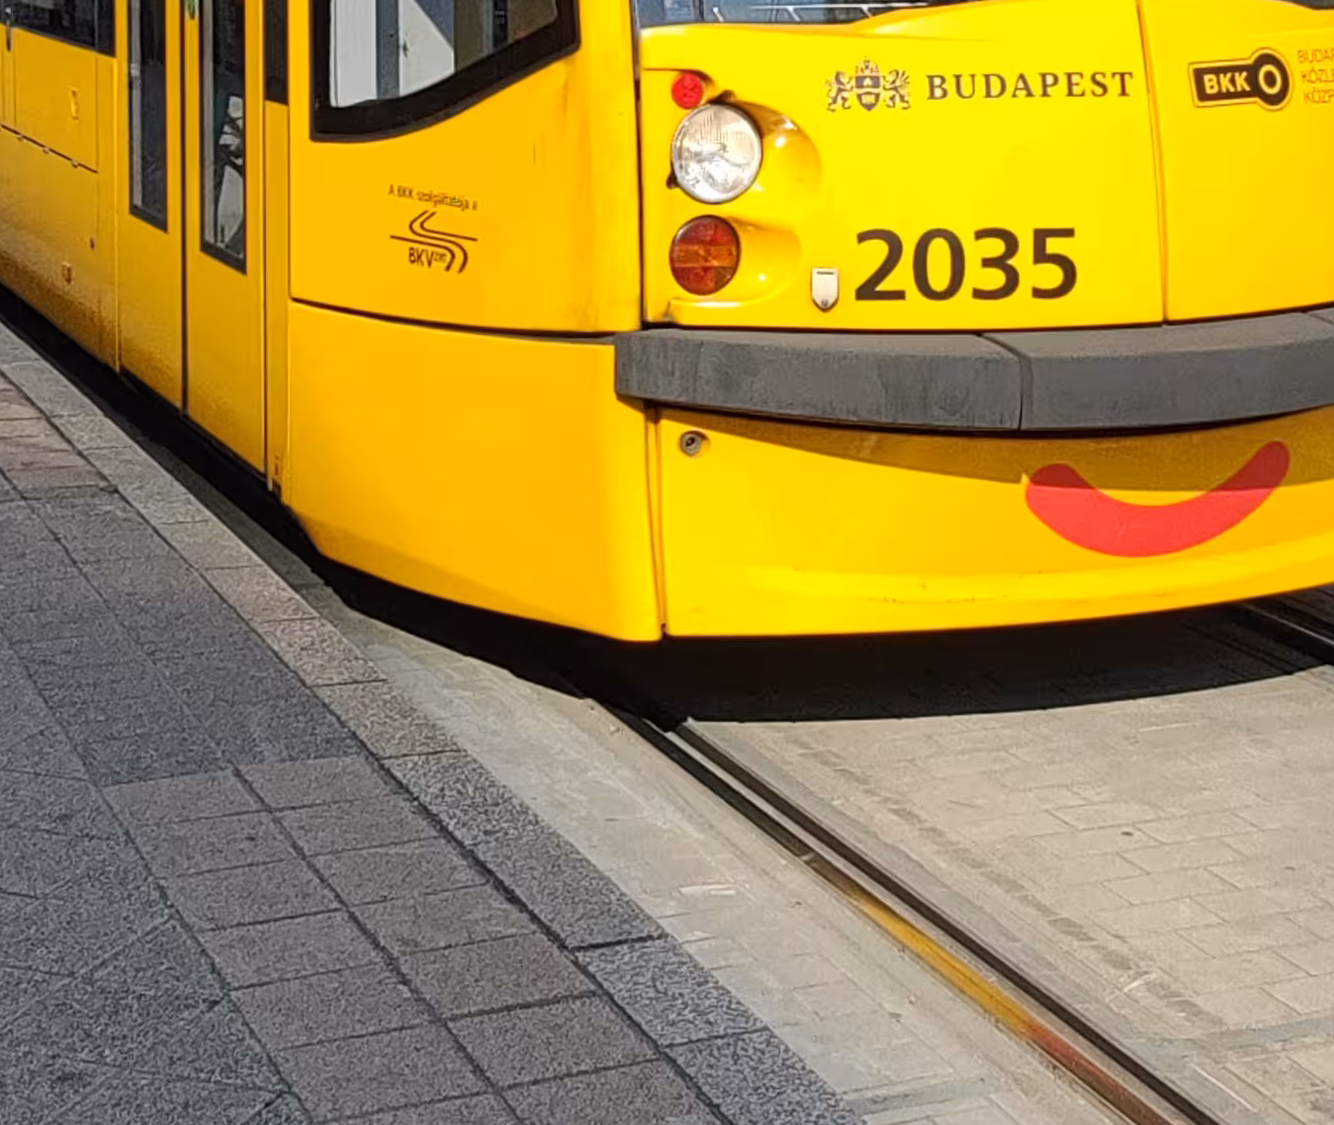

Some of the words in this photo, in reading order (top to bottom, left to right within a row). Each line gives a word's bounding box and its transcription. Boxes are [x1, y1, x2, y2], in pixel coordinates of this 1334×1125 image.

[925, 70, 1135, 101] BUDAPEST
[1203, 71, 1252, 95] BKK
[408, 246, 434, 269] BKV
[854, 226, 1078, 302] 2035
